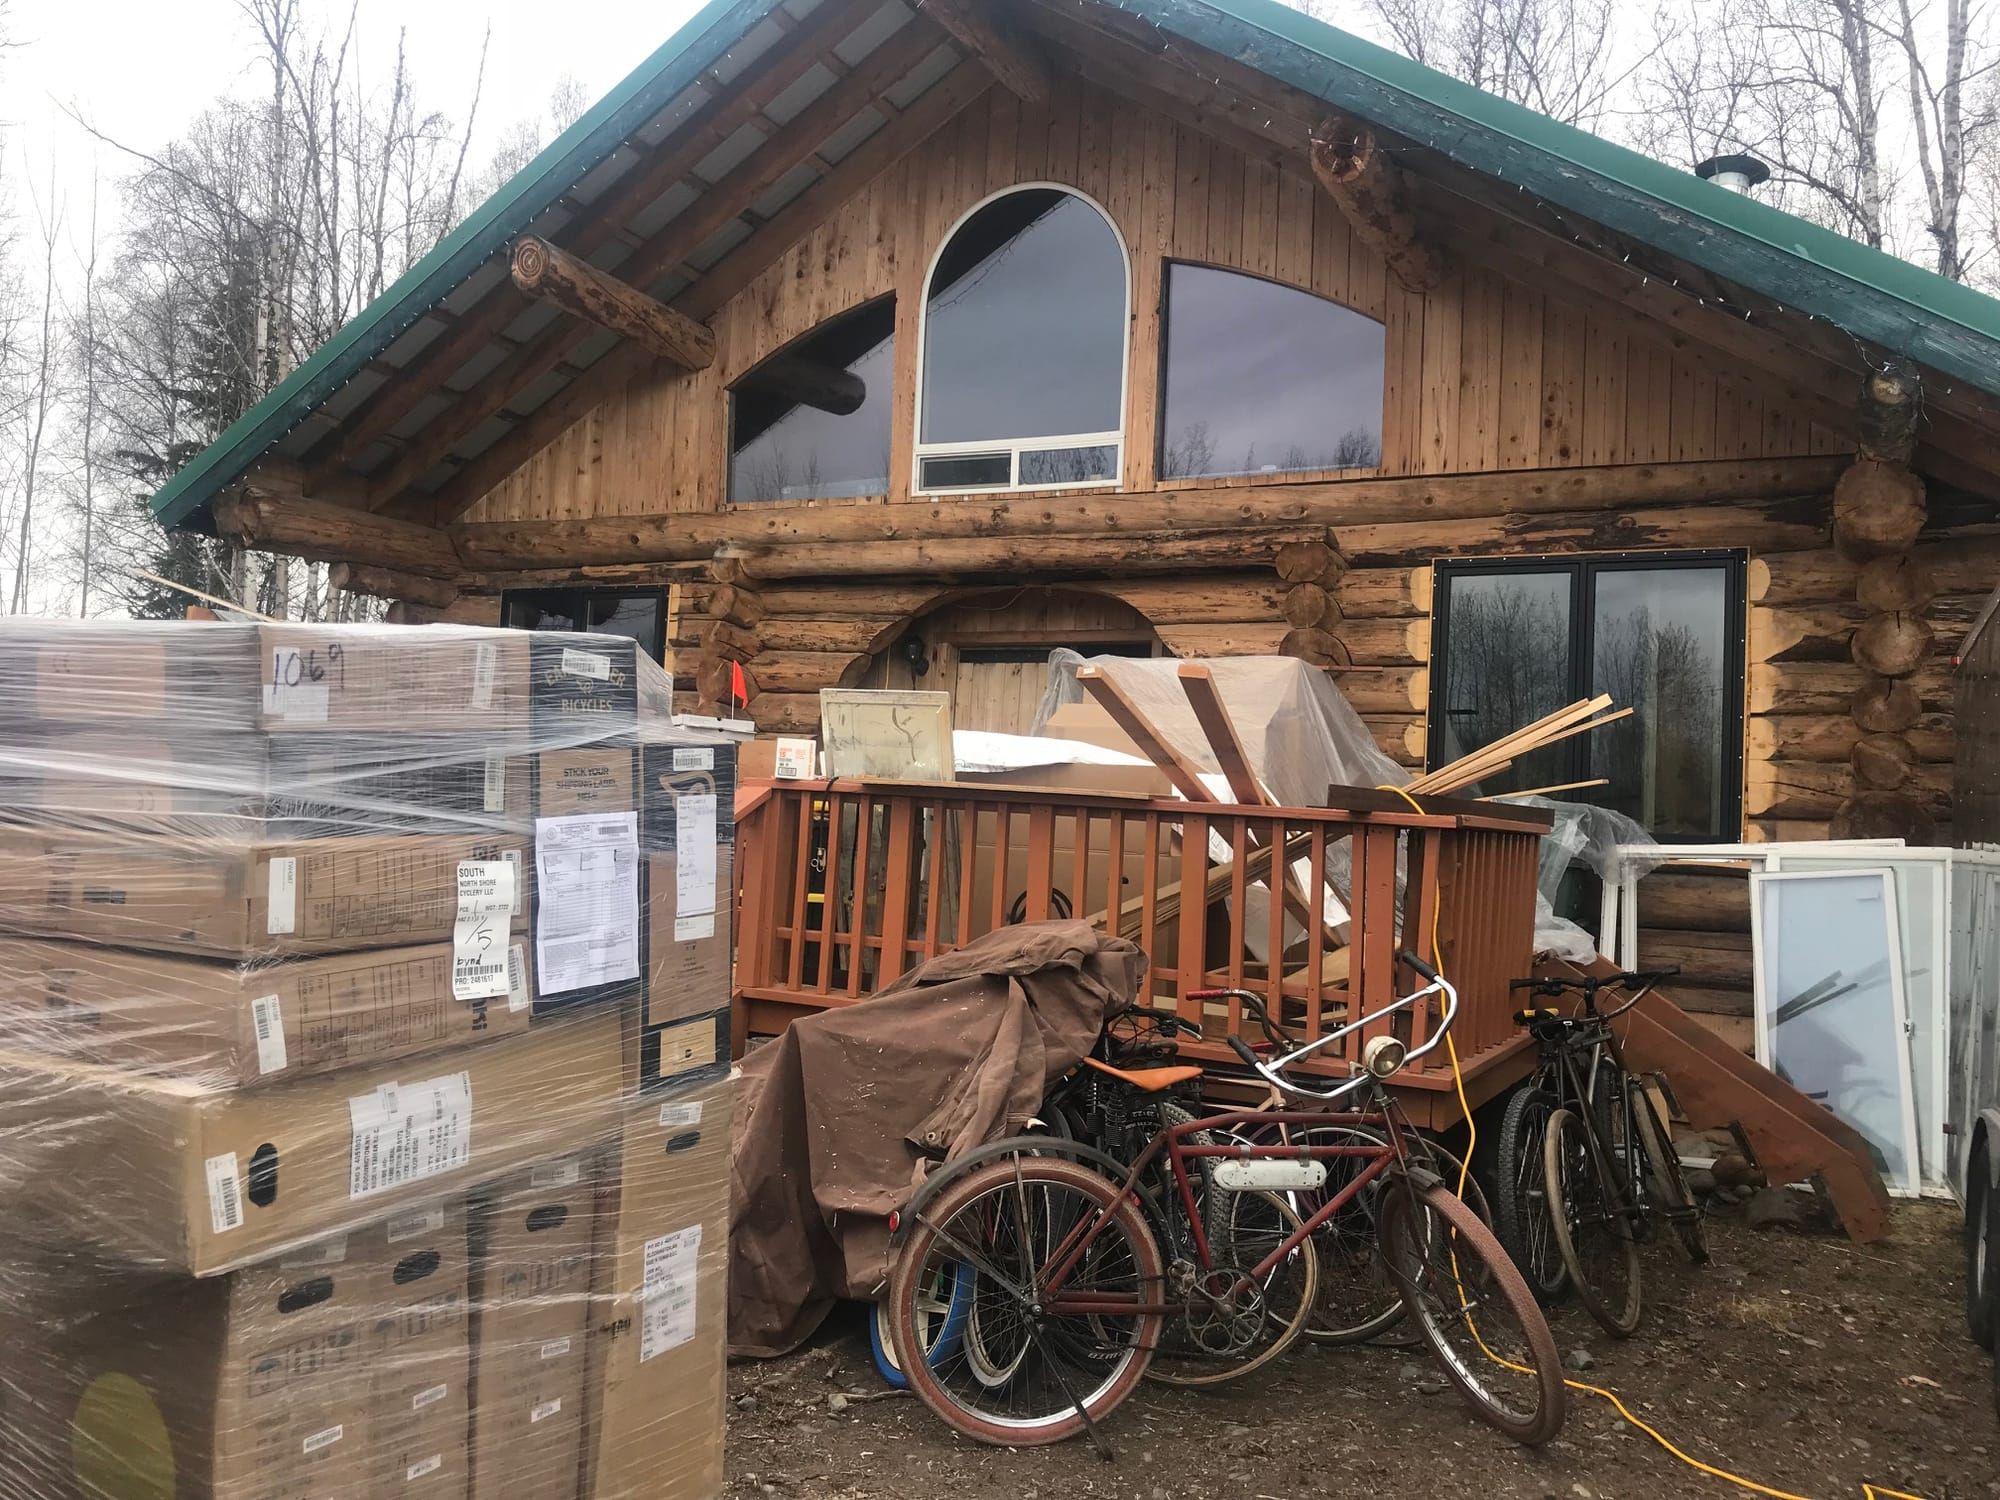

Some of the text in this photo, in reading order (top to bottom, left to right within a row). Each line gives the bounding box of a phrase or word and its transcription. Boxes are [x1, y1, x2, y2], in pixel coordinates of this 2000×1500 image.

[561, 698, 613, 711] BICYCLES
[563, 767, 609, 777] STICK YOUR
[459, 867, 485, 878] SOUTH
[479, 879, 497, 887] SHORE
